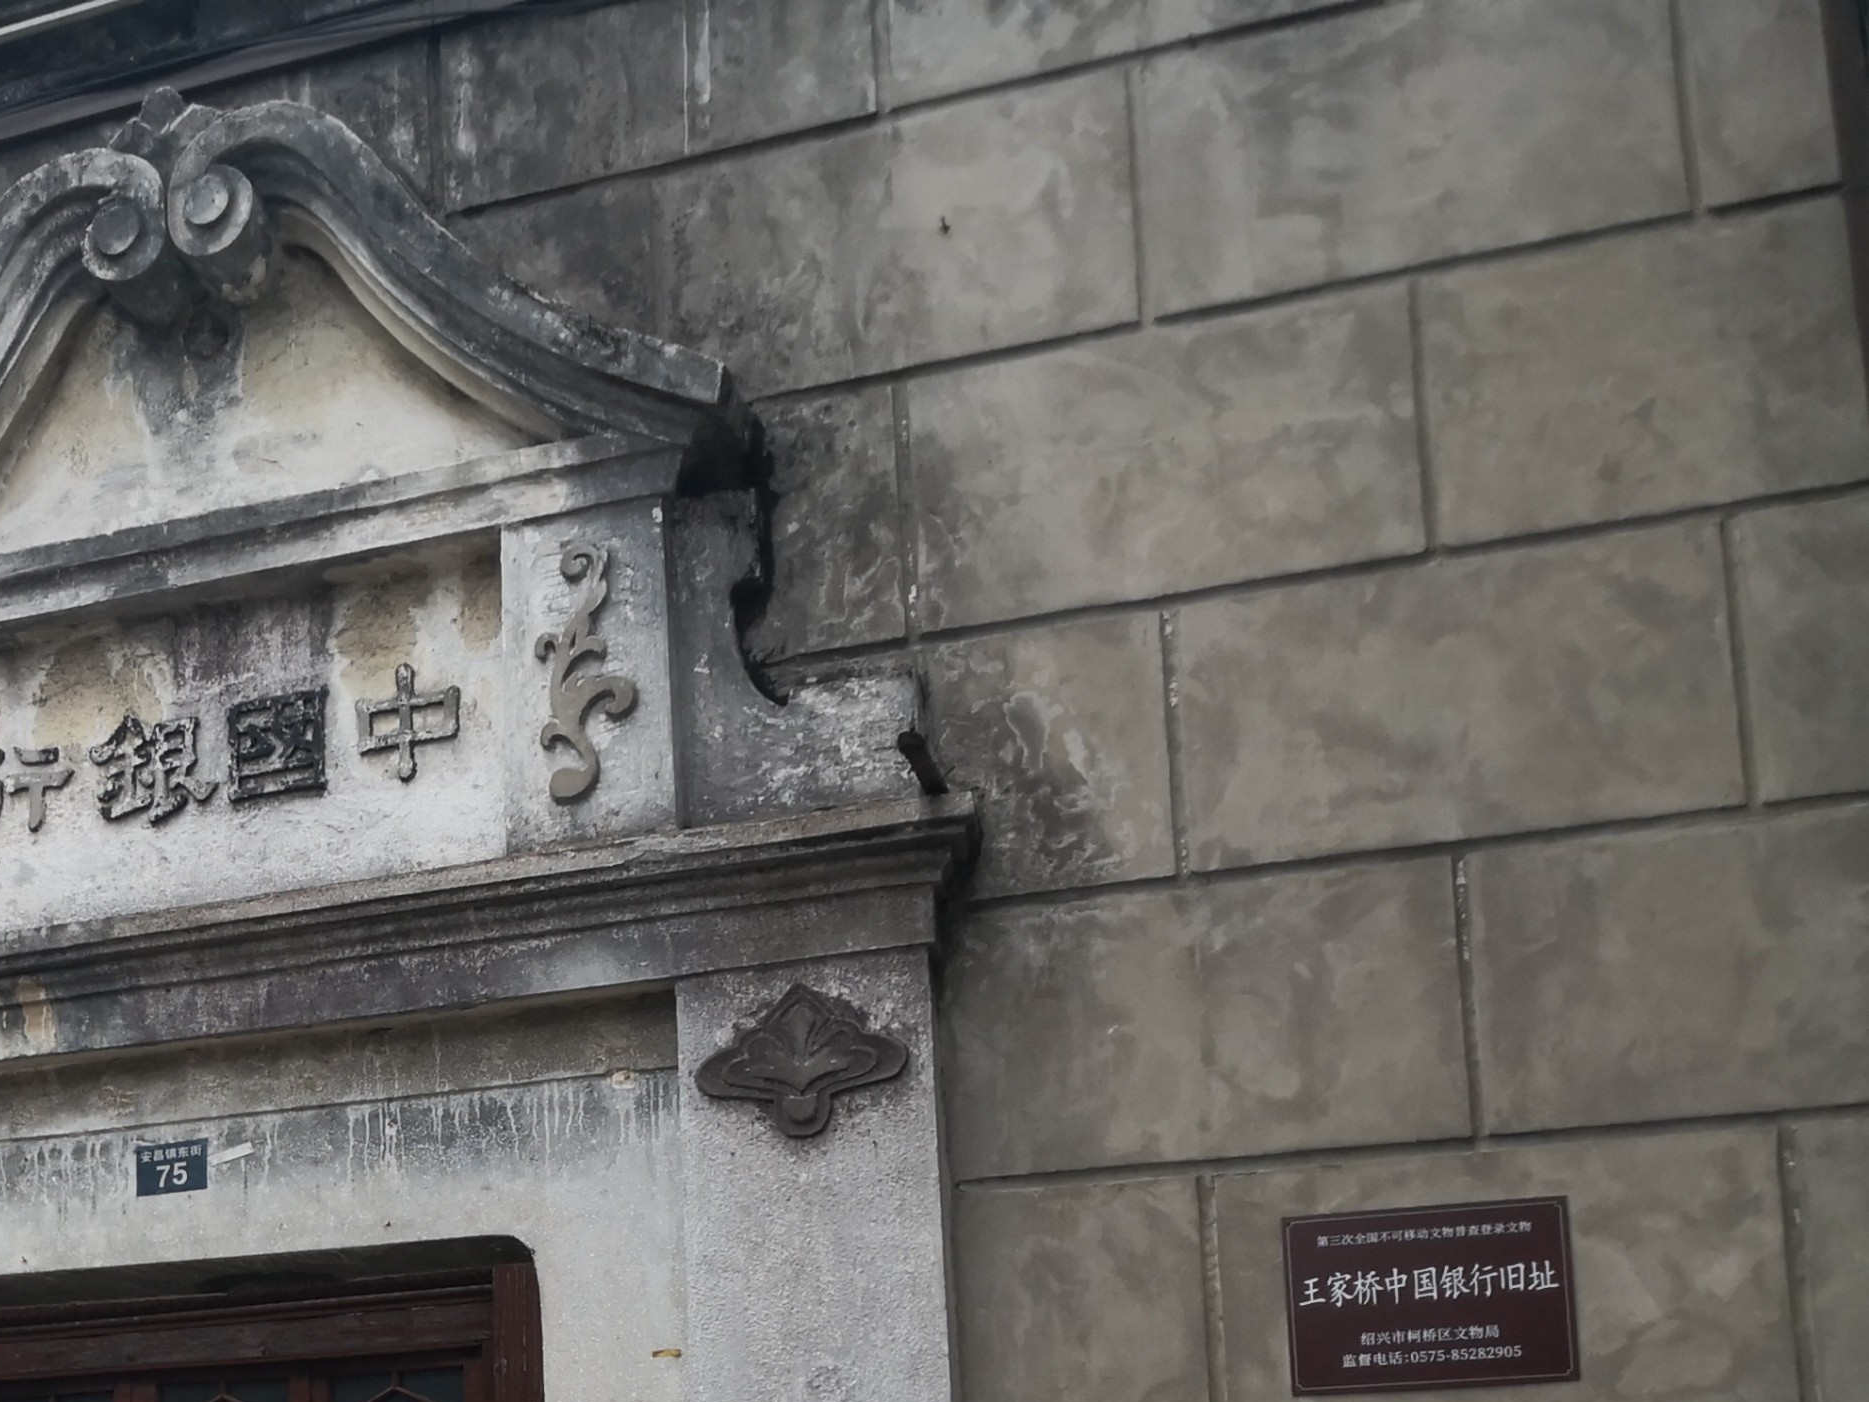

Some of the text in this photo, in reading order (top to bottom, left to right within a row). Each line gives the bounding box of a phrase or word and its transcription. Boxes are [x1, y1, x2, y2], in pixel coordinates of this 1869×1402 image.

[156, 1161, 188, 1188] 75
[1298, 1259, 1559, 1308] 王家桥中国银行旧址
[1360, 1324, 1500, 1346] 绍兴市柯桥区文物局
